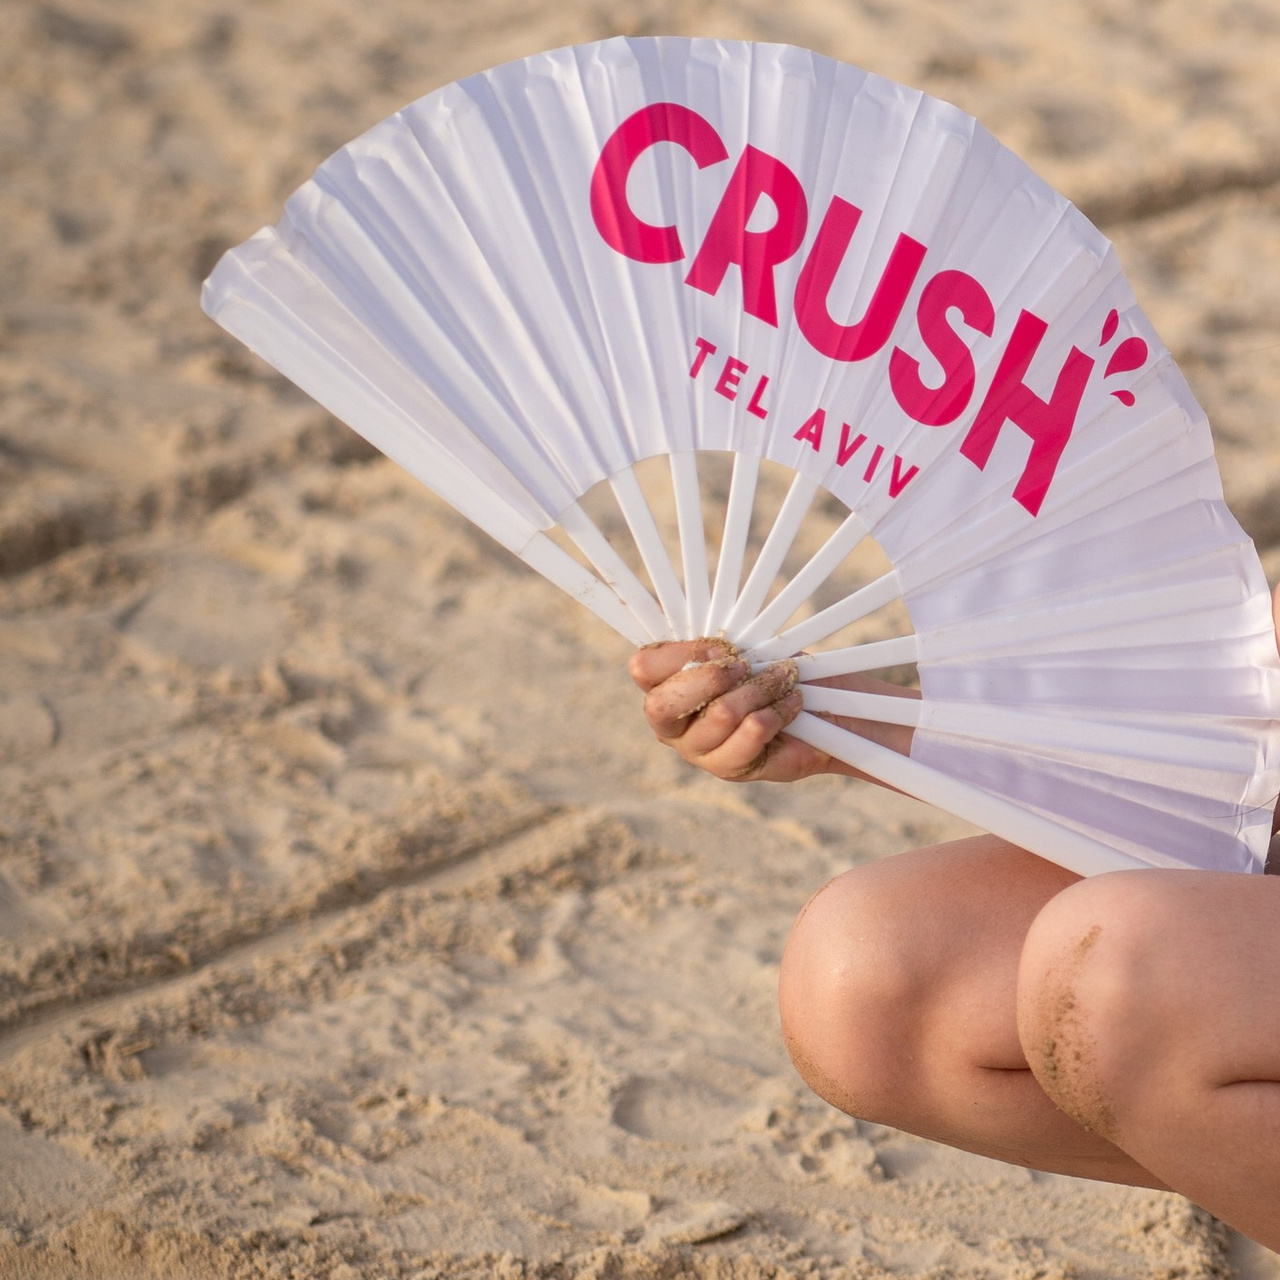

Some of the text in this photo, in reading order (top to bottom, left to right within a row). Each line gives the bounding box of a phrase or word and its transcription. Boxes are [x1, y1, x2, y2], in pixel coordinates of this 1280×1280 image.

[590, 102, 1095, 518] CRUSH
[689, 336, 920, 499] TEL AVIV
